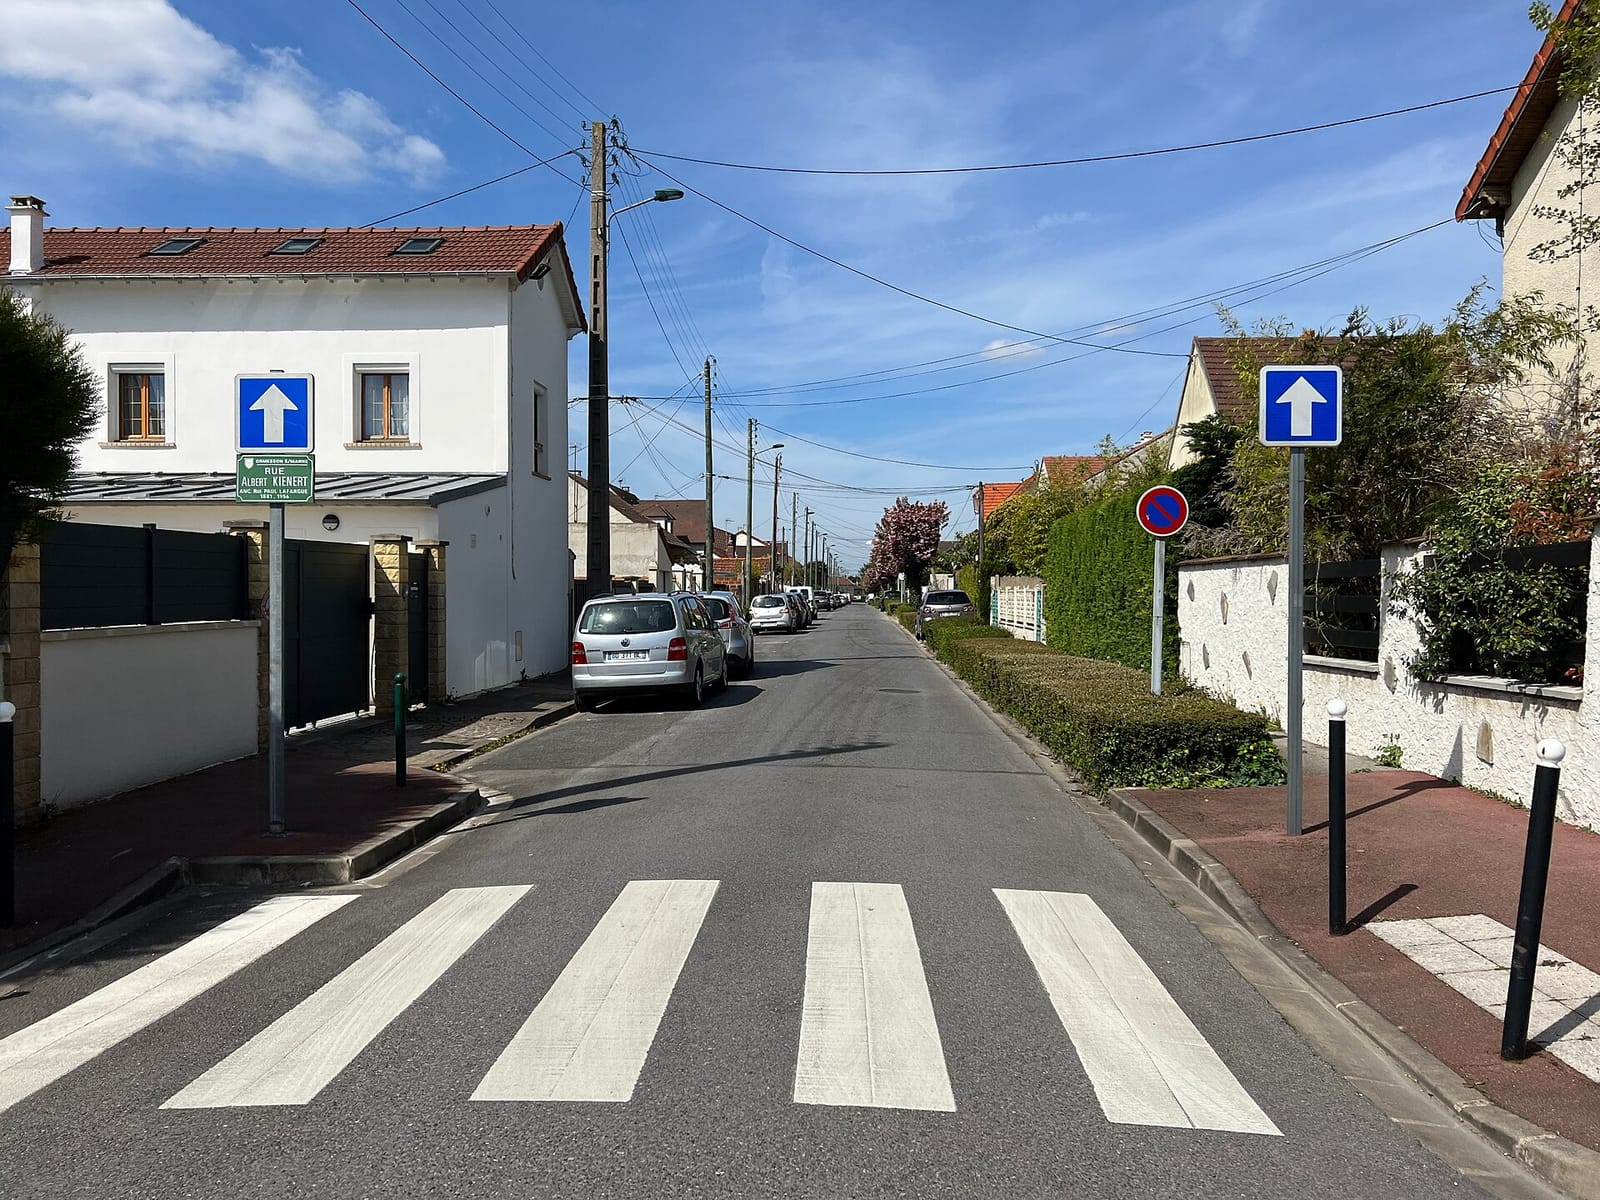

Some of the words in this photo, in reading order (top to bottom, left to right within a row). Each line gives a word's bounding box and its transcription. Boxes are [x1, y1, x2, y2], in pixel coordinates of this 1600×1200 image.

[264, 467, 285, 475] RUE
[241, 476, 267, 487] ALBERT
[272, 476, 308, 487] KIENERT
